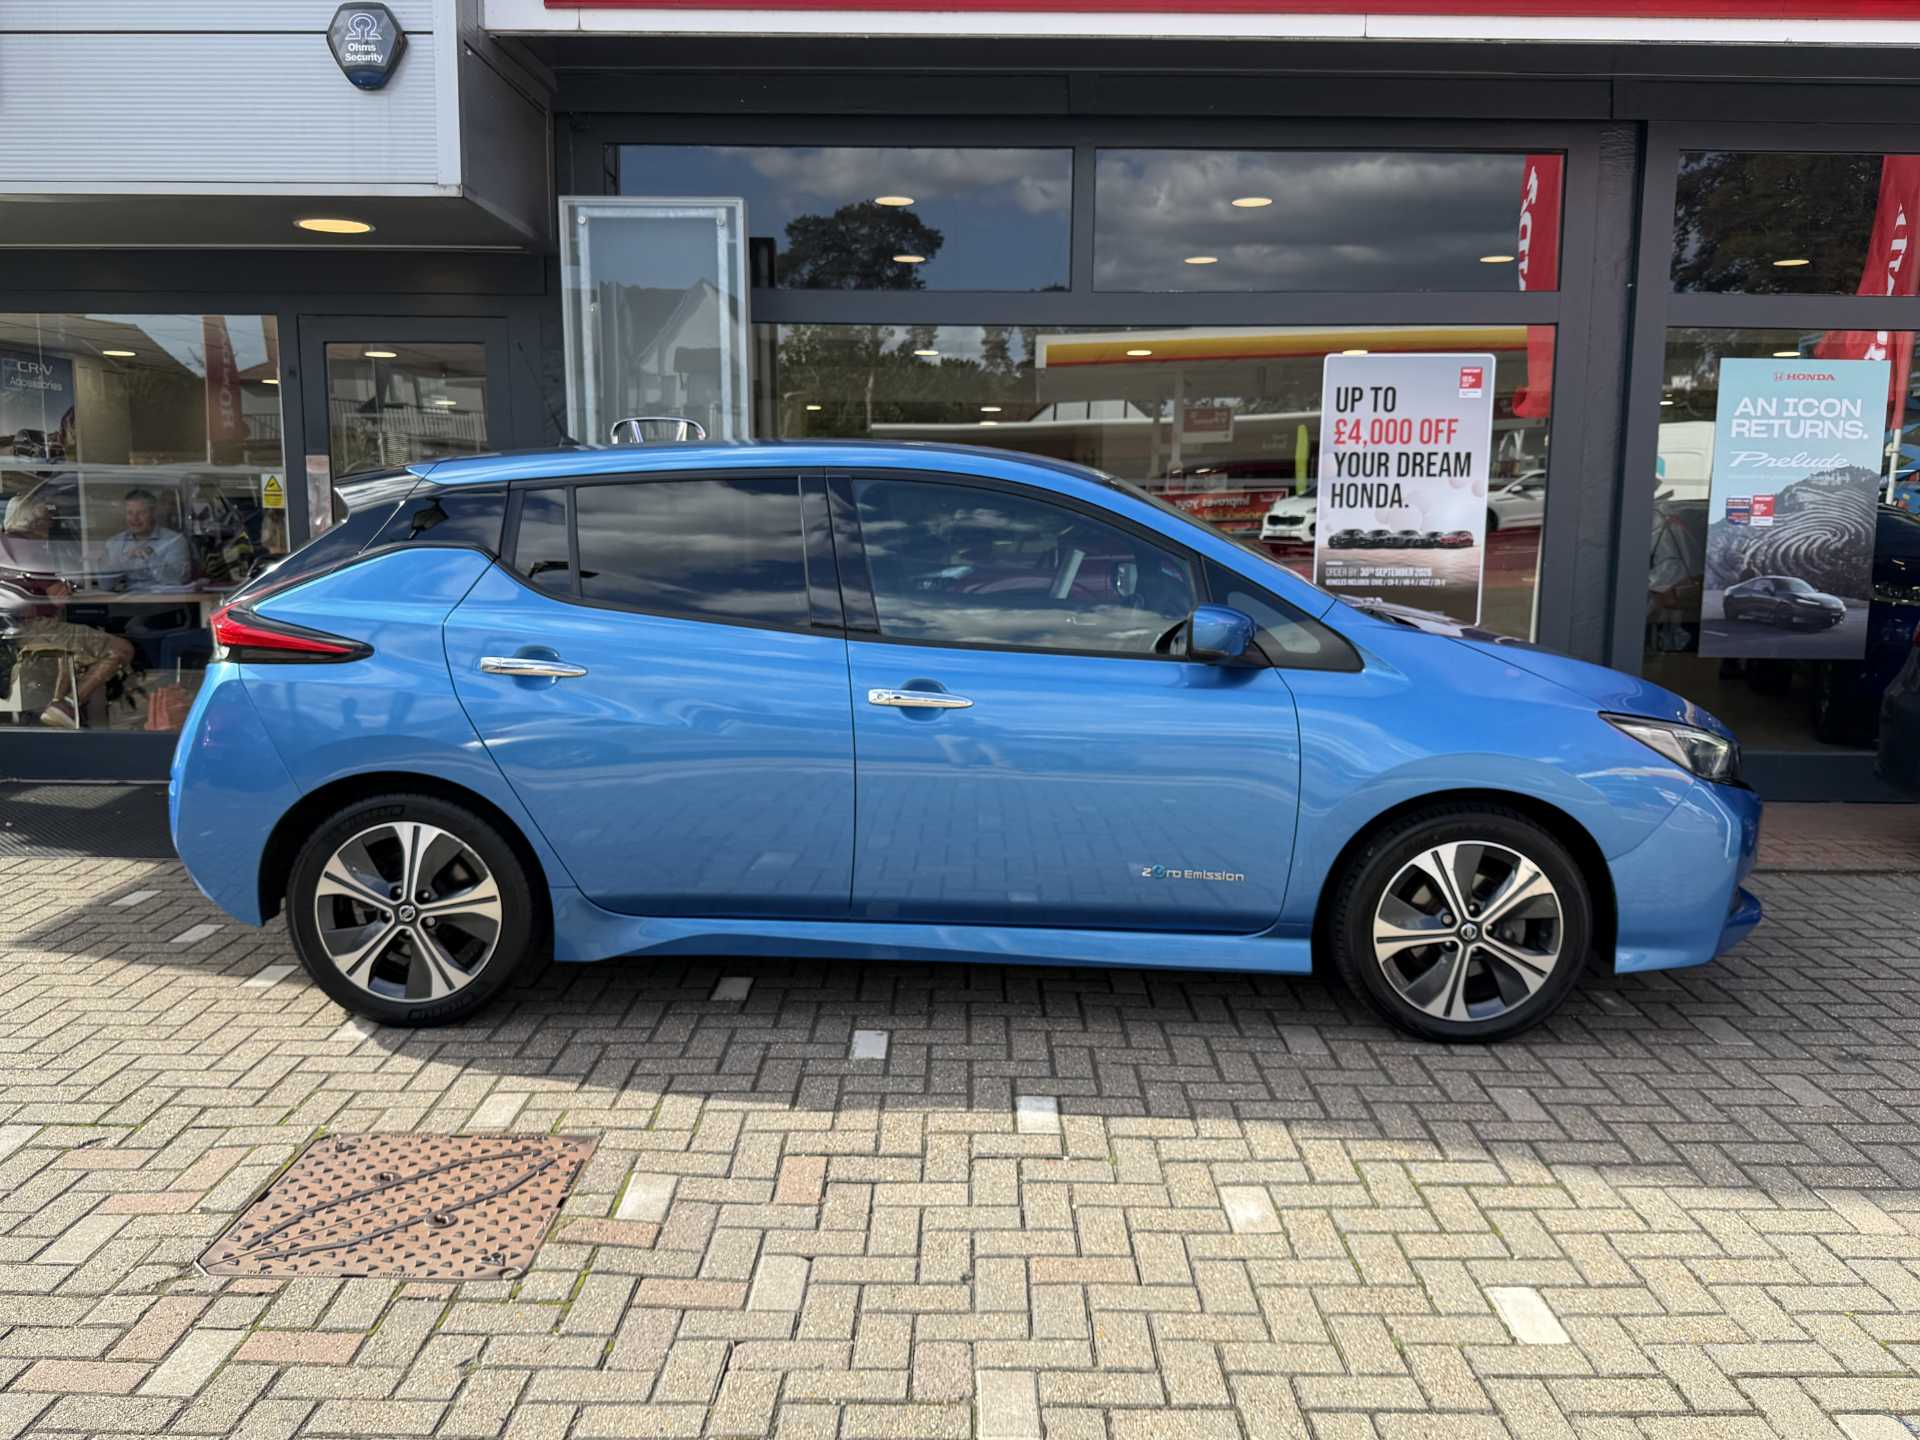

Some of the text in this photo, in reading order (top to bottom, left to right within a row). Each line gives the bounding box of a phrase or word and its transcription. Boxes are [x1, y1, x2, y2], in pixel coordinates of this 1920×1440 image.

[344, 52, 383, 63] Security
[347, 42, 377, 52] Ohms
[1786, 372, 1836, 381] HONDA
[1336, 386, 1397, 413] UP TO
[1733, 397, 1863, 418] AN ICON
[1334, 418, 1459, 448] £4,000 OFF
[1731, 418, 1869, 440] RETURNS.
[1334, 451, 1472, 478] YOUR DREAM
[1729, 450, 1851, 468] Prelude
[1330, 483, 1409, 509] HONDA.
[1183, 869, 1245, 881] Emission
